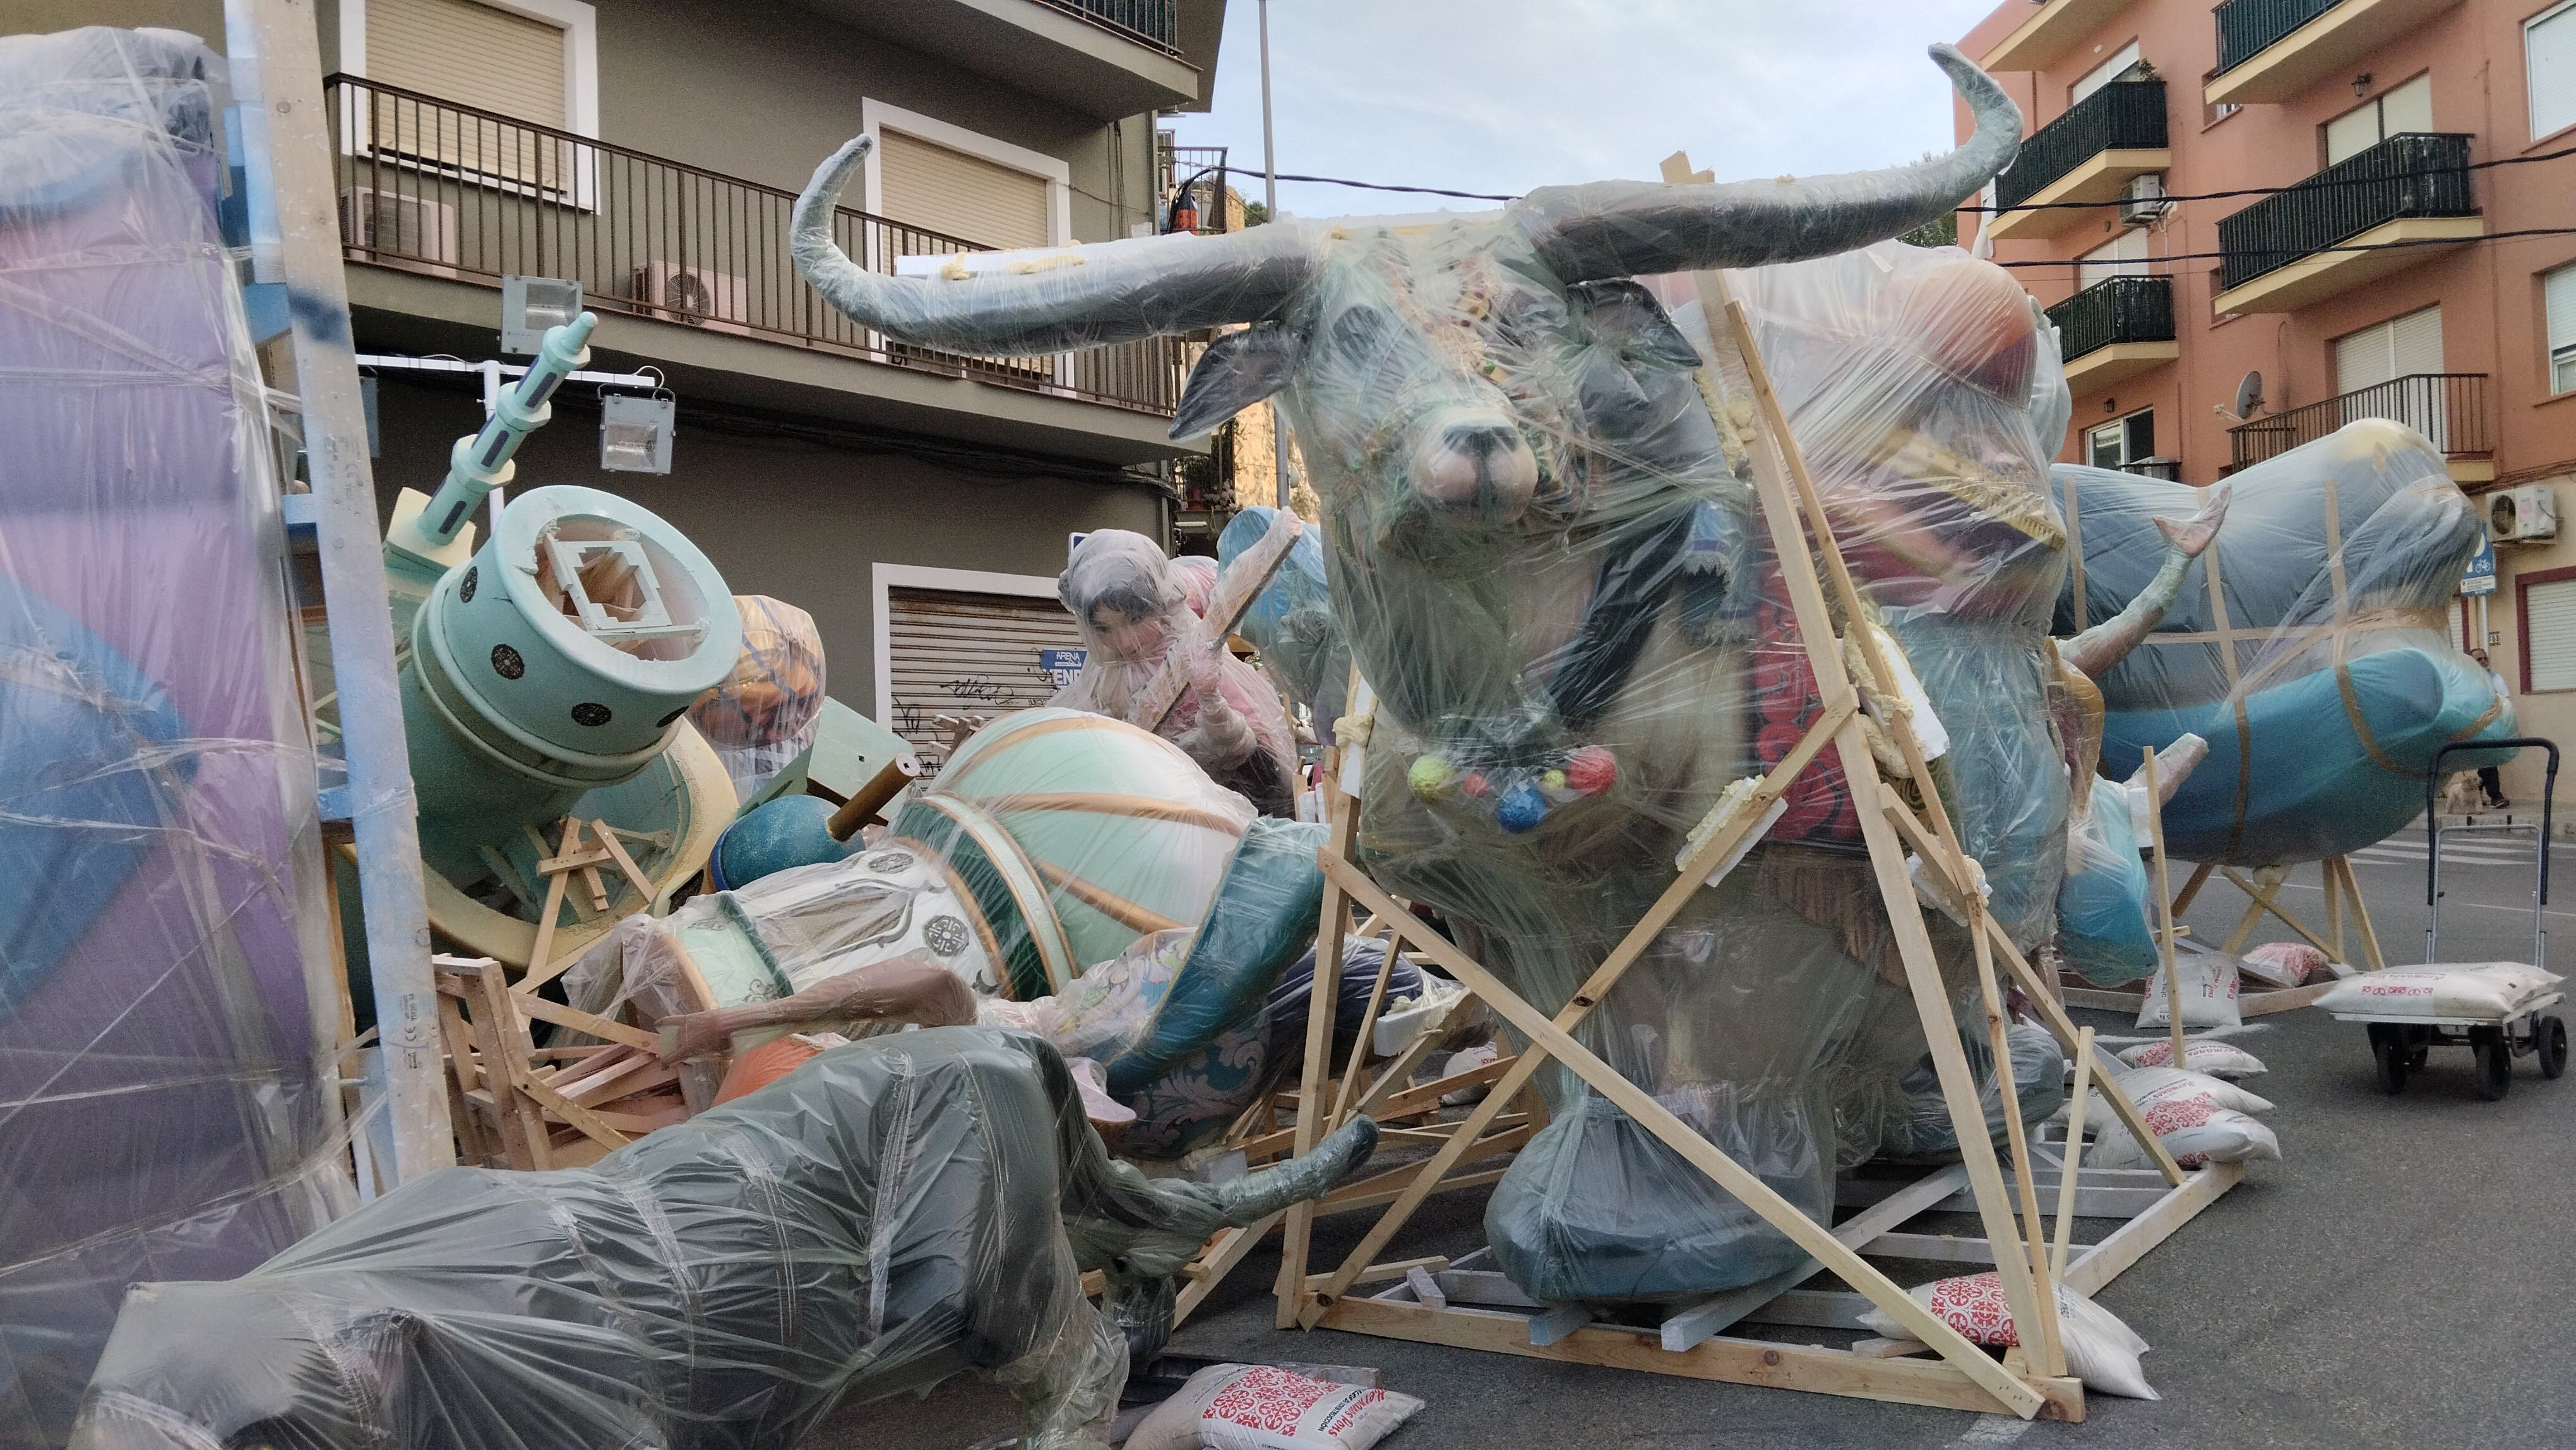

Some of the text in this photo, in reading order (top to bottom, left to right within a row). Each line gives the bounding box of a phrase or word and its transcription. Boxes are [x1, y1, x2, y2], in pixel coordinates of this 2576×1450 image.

[1056, 651, 1080, 661] ARENA
[1328, 1388, 1385, 1437] Hermanos Pons
